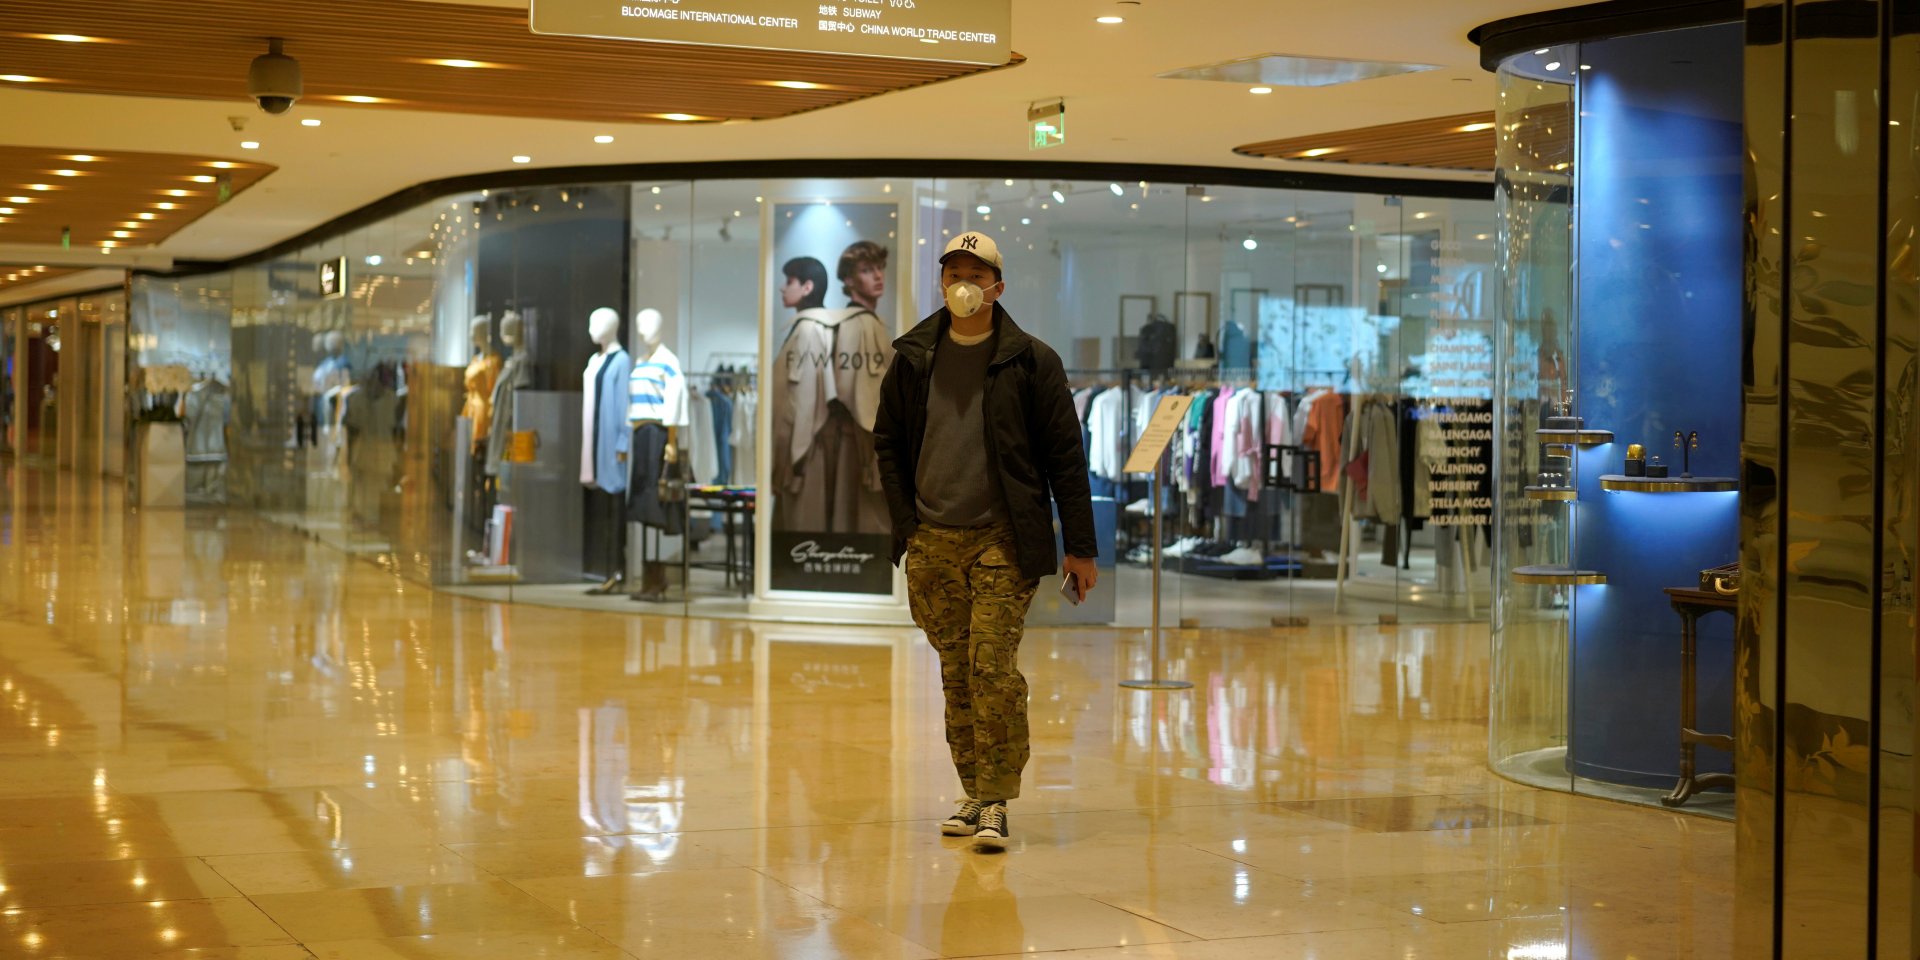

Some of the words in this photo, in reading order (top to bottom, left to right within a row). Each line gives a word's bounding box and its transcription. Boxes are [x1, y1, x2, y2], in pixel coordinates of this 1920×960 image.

[819, 5, 838, 16] 地铁
[843, 7, 882, 19] SUBWAY
[621, 6, 679, 20] BLOOMAGE
[680, 10, 757, 26] INTERNATIONAL
[758, 16, 798, 29] CENTER
[818, 20, 856, 33] 国贸中心
[860, 23, 890, 36] CHINA
[891, 26, 926, 38] WORLD
[927, 29, 958, 41] TRADE
[959, 31, 996, 44] CENTER
[839, 352, 885, 371] 2019
[1429, 430, 1492, 440] BALENCIAGA
[1429, 447, 1480, 457] GIVENCHY
[1428, 464, 1486, 474] VALENTINO
[1428, 481, 1479, 491] BURBERRY
[1428, 498, 1460, 508] STELLA
[1428, 515, 1487, 525] ALEXANDER
